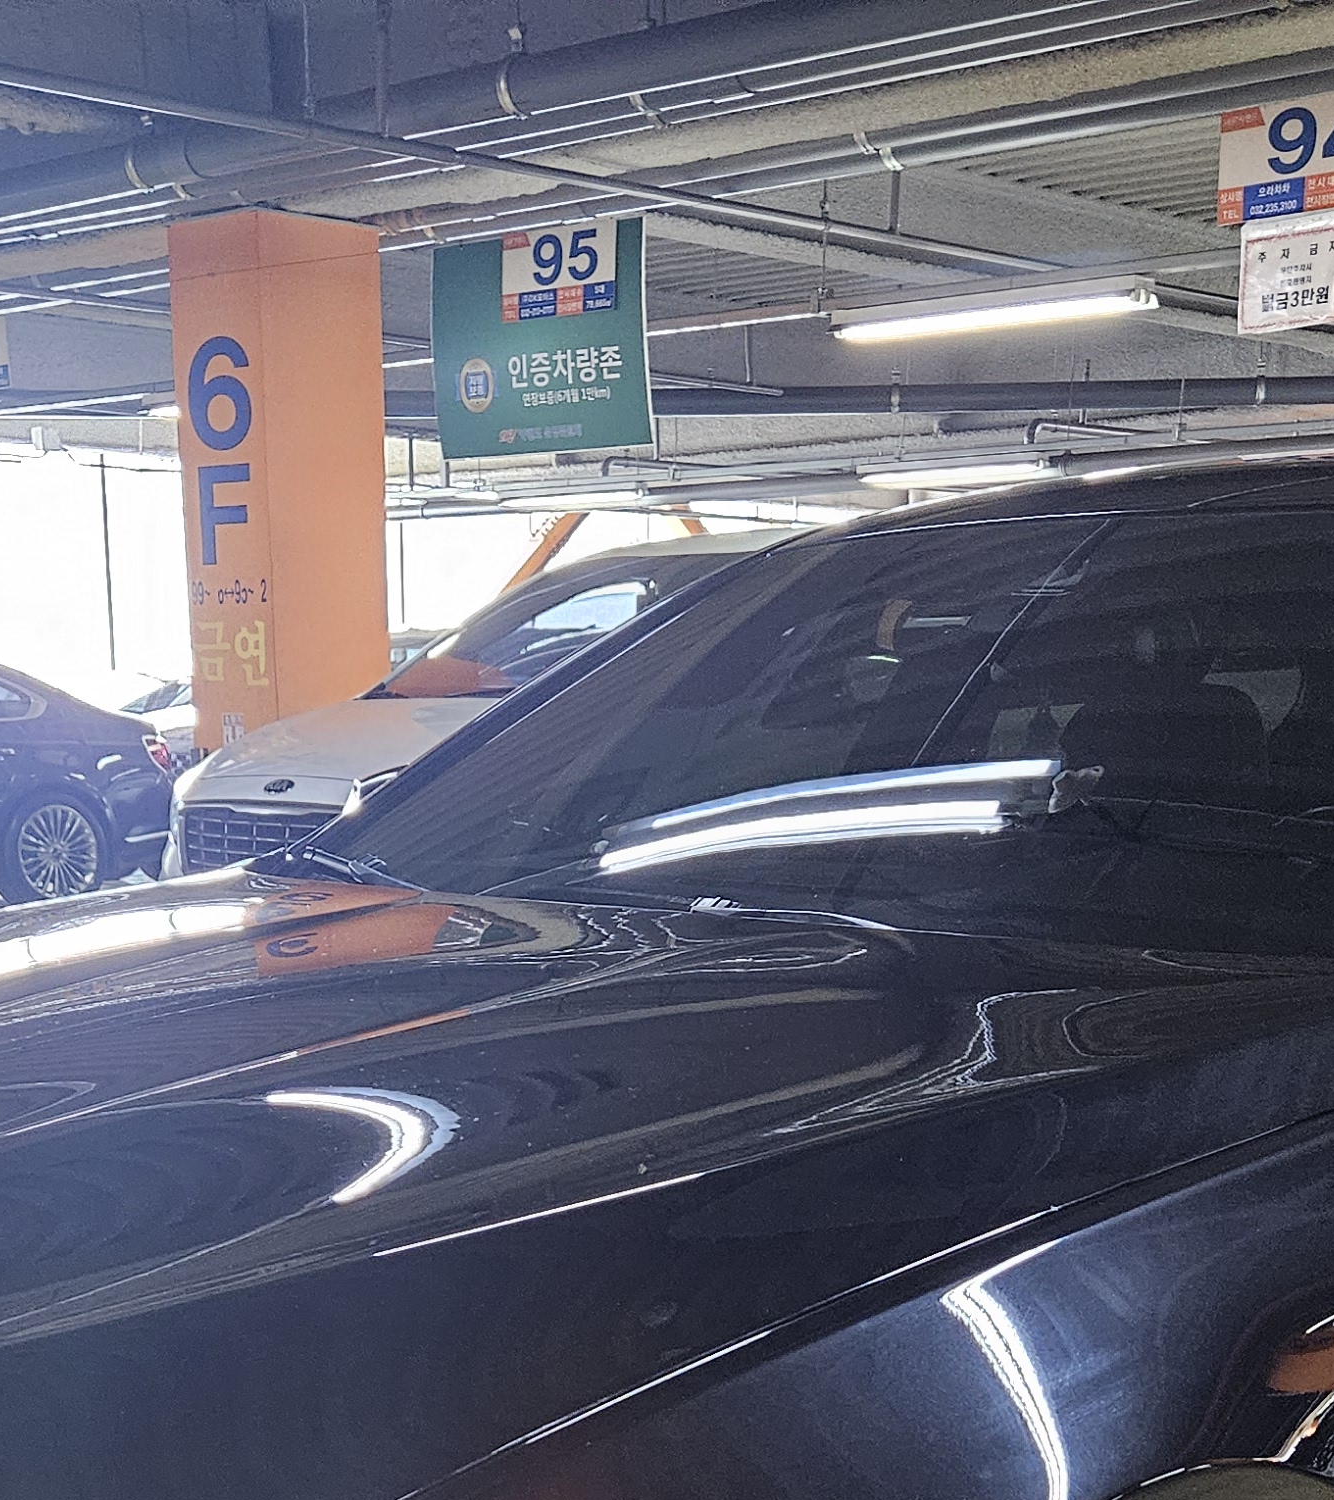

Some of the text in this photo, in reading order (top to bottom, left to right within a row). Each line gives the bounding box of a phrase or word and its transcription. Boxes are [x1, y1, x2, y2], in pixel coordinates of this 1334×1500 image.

[1222, 208, 1240, 220] TEL
[532, 228, 599, 286] 95
[508, 345, 623, 389] 인증차량존
[194, 619, 270, 686] 금연
